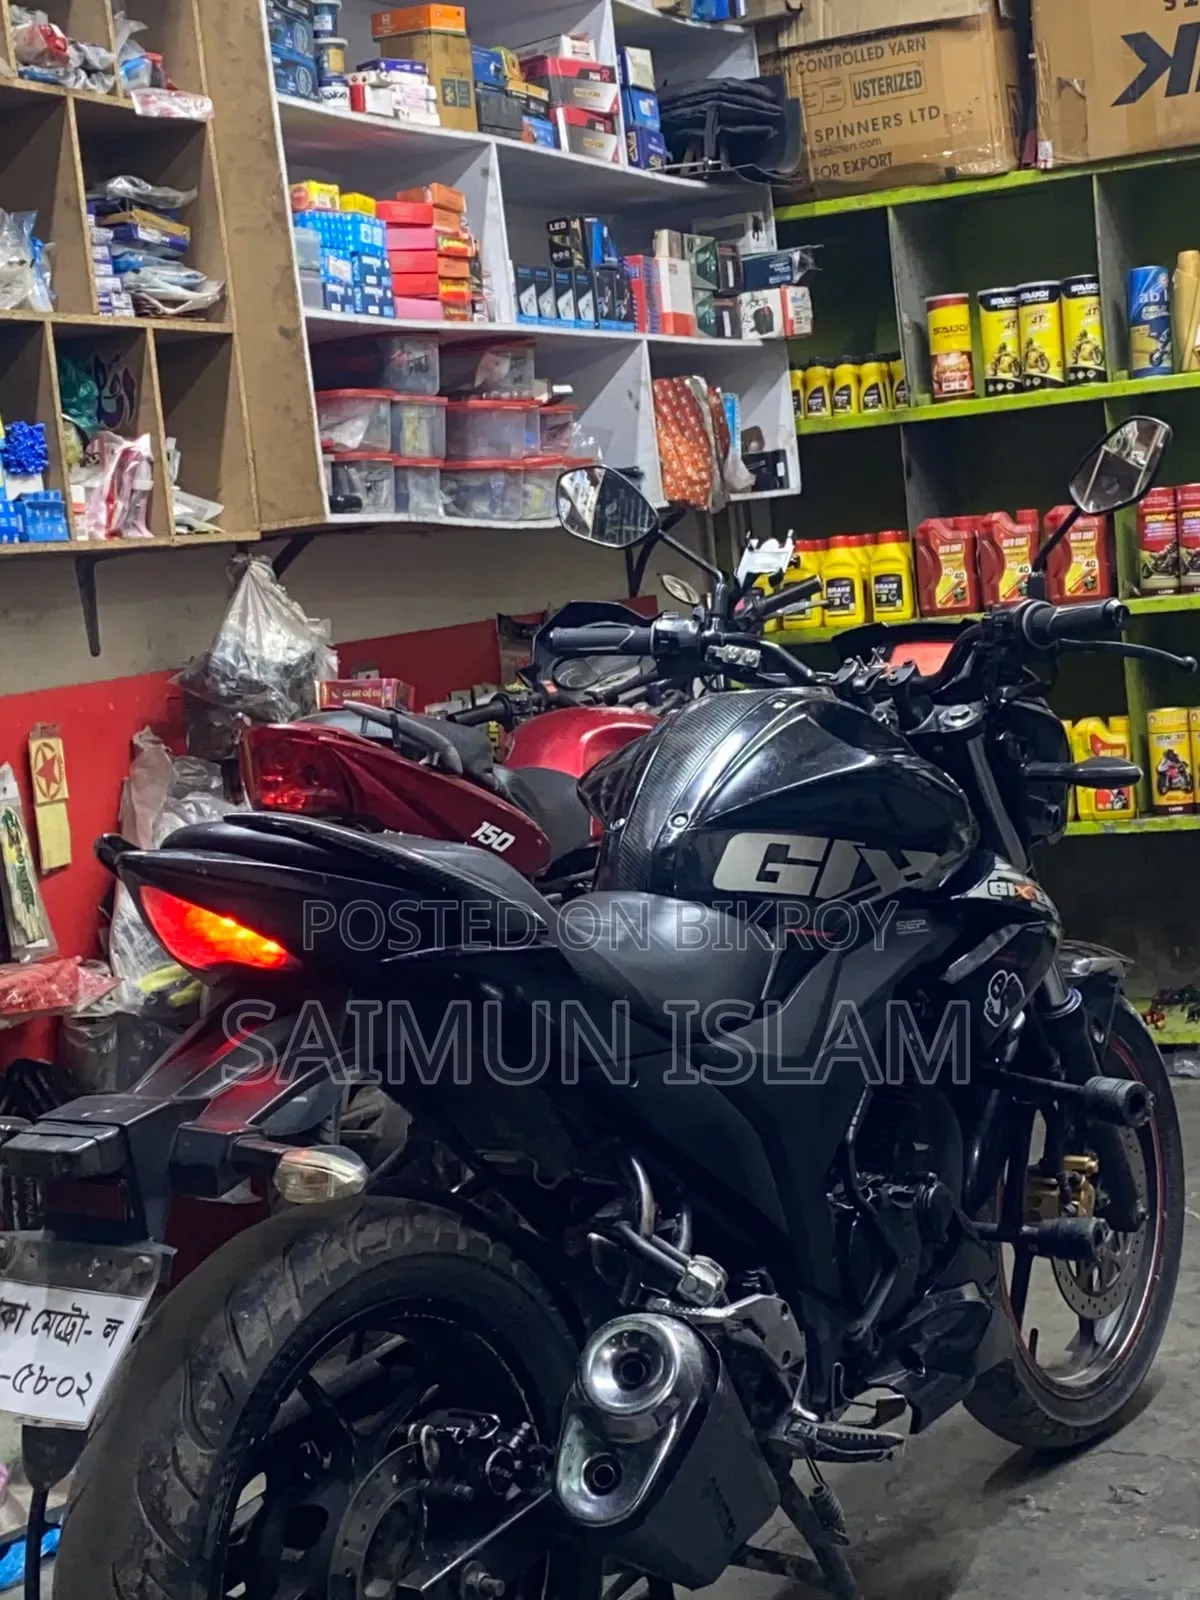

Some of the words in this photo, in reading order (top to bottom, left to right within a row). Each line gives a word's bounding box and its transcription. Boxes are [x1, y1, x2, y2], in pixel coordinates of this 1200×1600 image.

[796, 49, 885, 76] CONTROLLED
[888, 36, 927, 57] YARN
[853, 69, 923, 100] USTERIZED
[814, 112, 904, 144] SPINNERS
[909, 105, 941, 125] LTD
[843, 152, 894, 176] EXPORT
[471, 821, 516, 853] 150
[0, 1298, 31, 1334] কা
